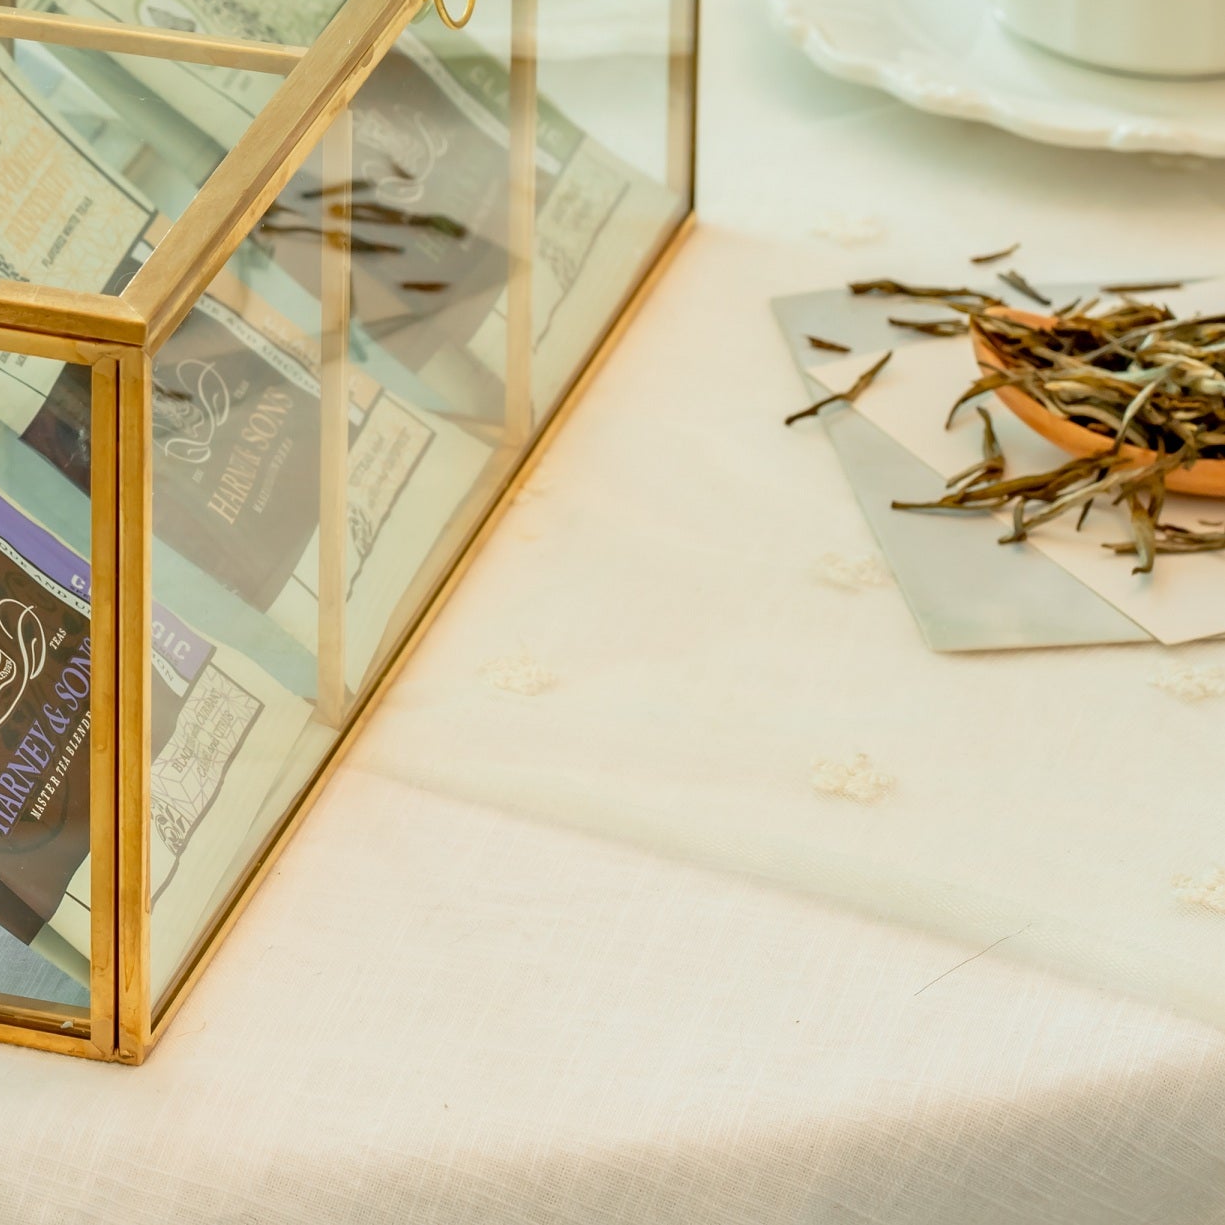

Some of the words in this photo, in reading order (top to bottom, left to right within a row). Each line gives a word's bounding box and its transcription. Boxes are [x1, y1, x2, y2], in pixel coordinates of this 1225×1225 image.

[34, 573, 68, 599] AND
[49, 627, 67, 650] TEAS
[42, 703, 71, 735] &
[30, 775, 61, 821] MASTER
[56, 754, 71, 778] TEA
[70, 710, 91, 757] BLENDE
